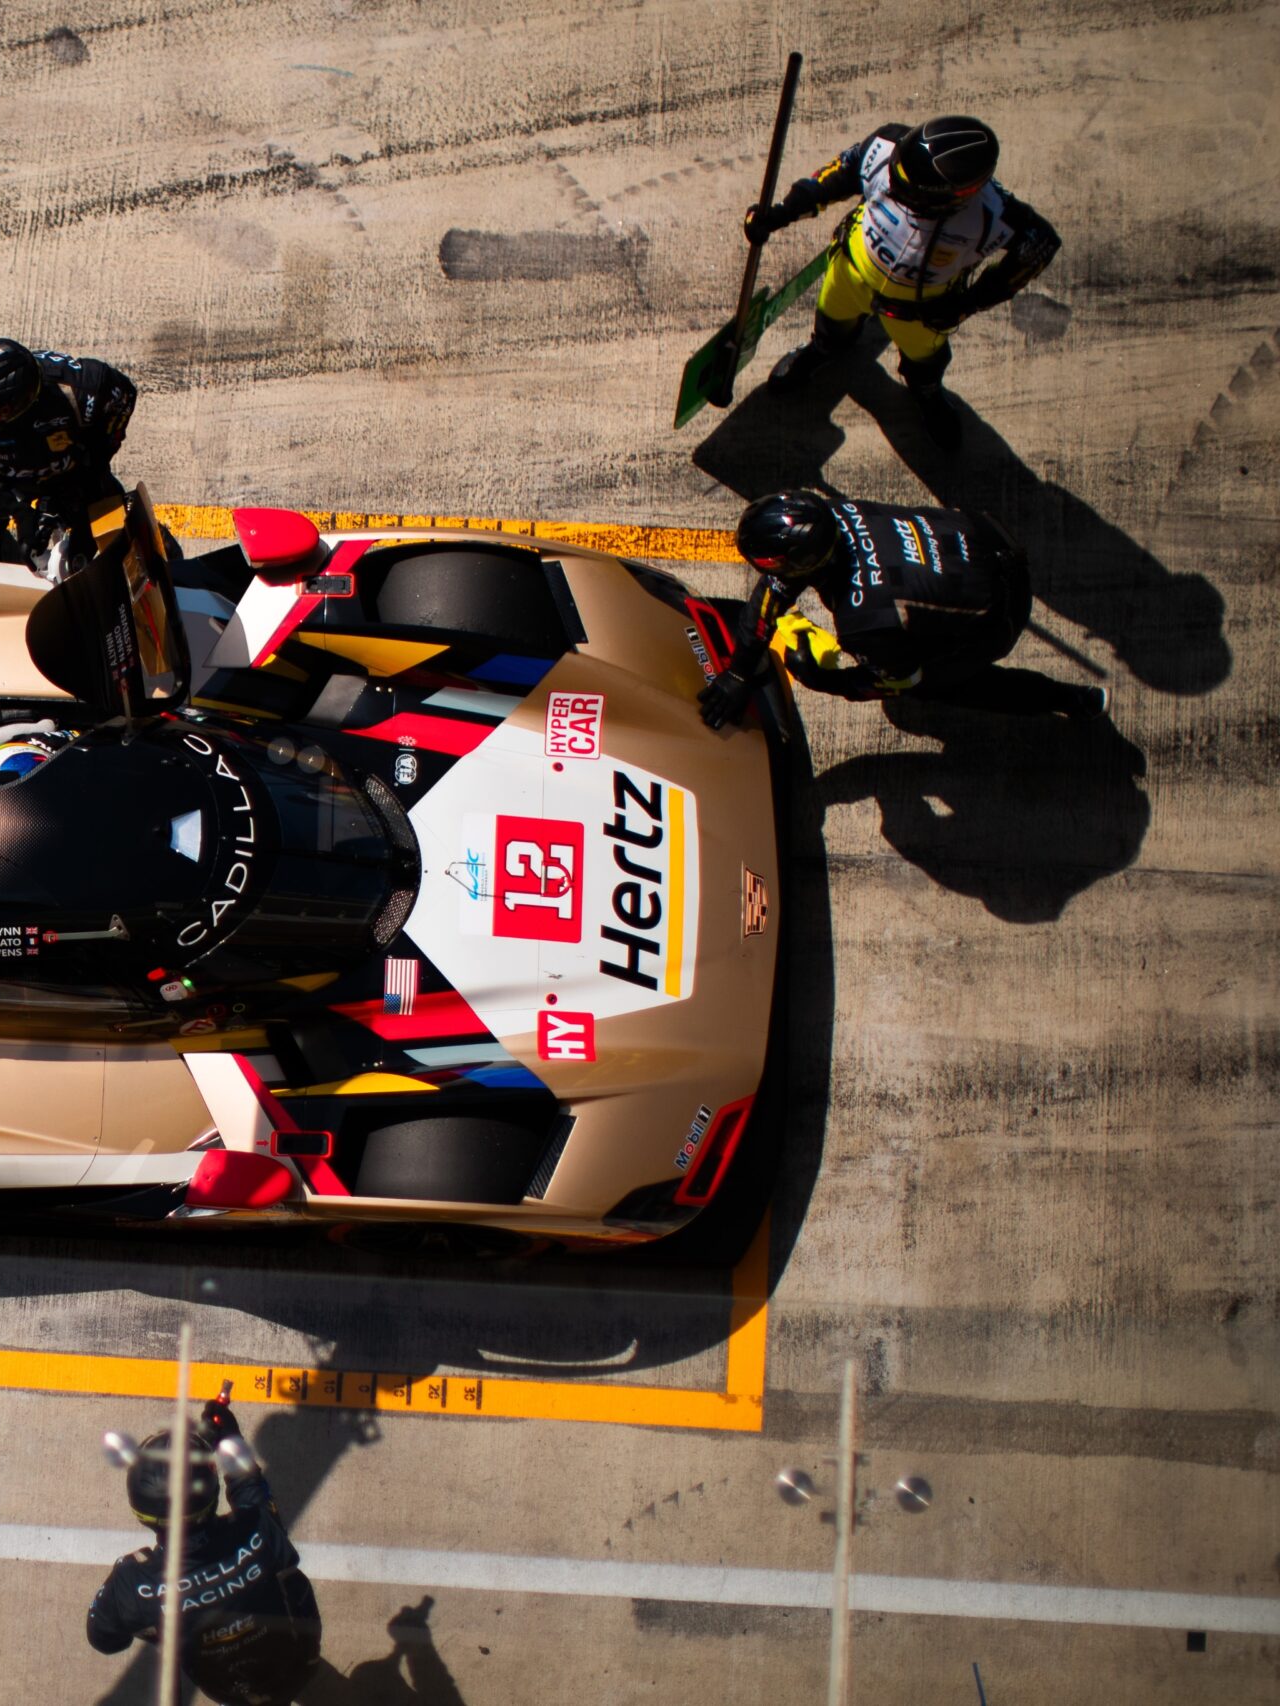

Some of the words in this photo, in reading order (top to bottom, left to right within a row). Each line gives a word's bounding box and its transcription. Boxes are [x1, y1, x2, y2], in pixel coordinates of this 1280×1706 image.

[843, 503, 882, 586] RACING
[893, 518, 920, 563] Hertz
[928, 537, 942, 574] Racing
[550, 697, 570, 753] HYPER
[568, 698, 600, 755] CAR
[177, 734, 255, 946] CADILLAC
[503, 839, 575, 921] 12
[599, 770, 663, 991] Hertz
[547, 1015, 587, 1060] HY
[676, 1122, 706, 1169] Mobil
[698, 1105, 712, 1122] 1
[255, 1376, 266, 1390] 30
[289, 1377, 300, 1392] 20
[324, 1380, 335, 1394] 10
[359, 1384, 369, 1393] 0
[394, 1383, 405, 1397] 10
[429, 1385, 440, 1399] 20
[464, 1386, 475, 1401] 30
[203, 1614, 254, 1643] Hertz
